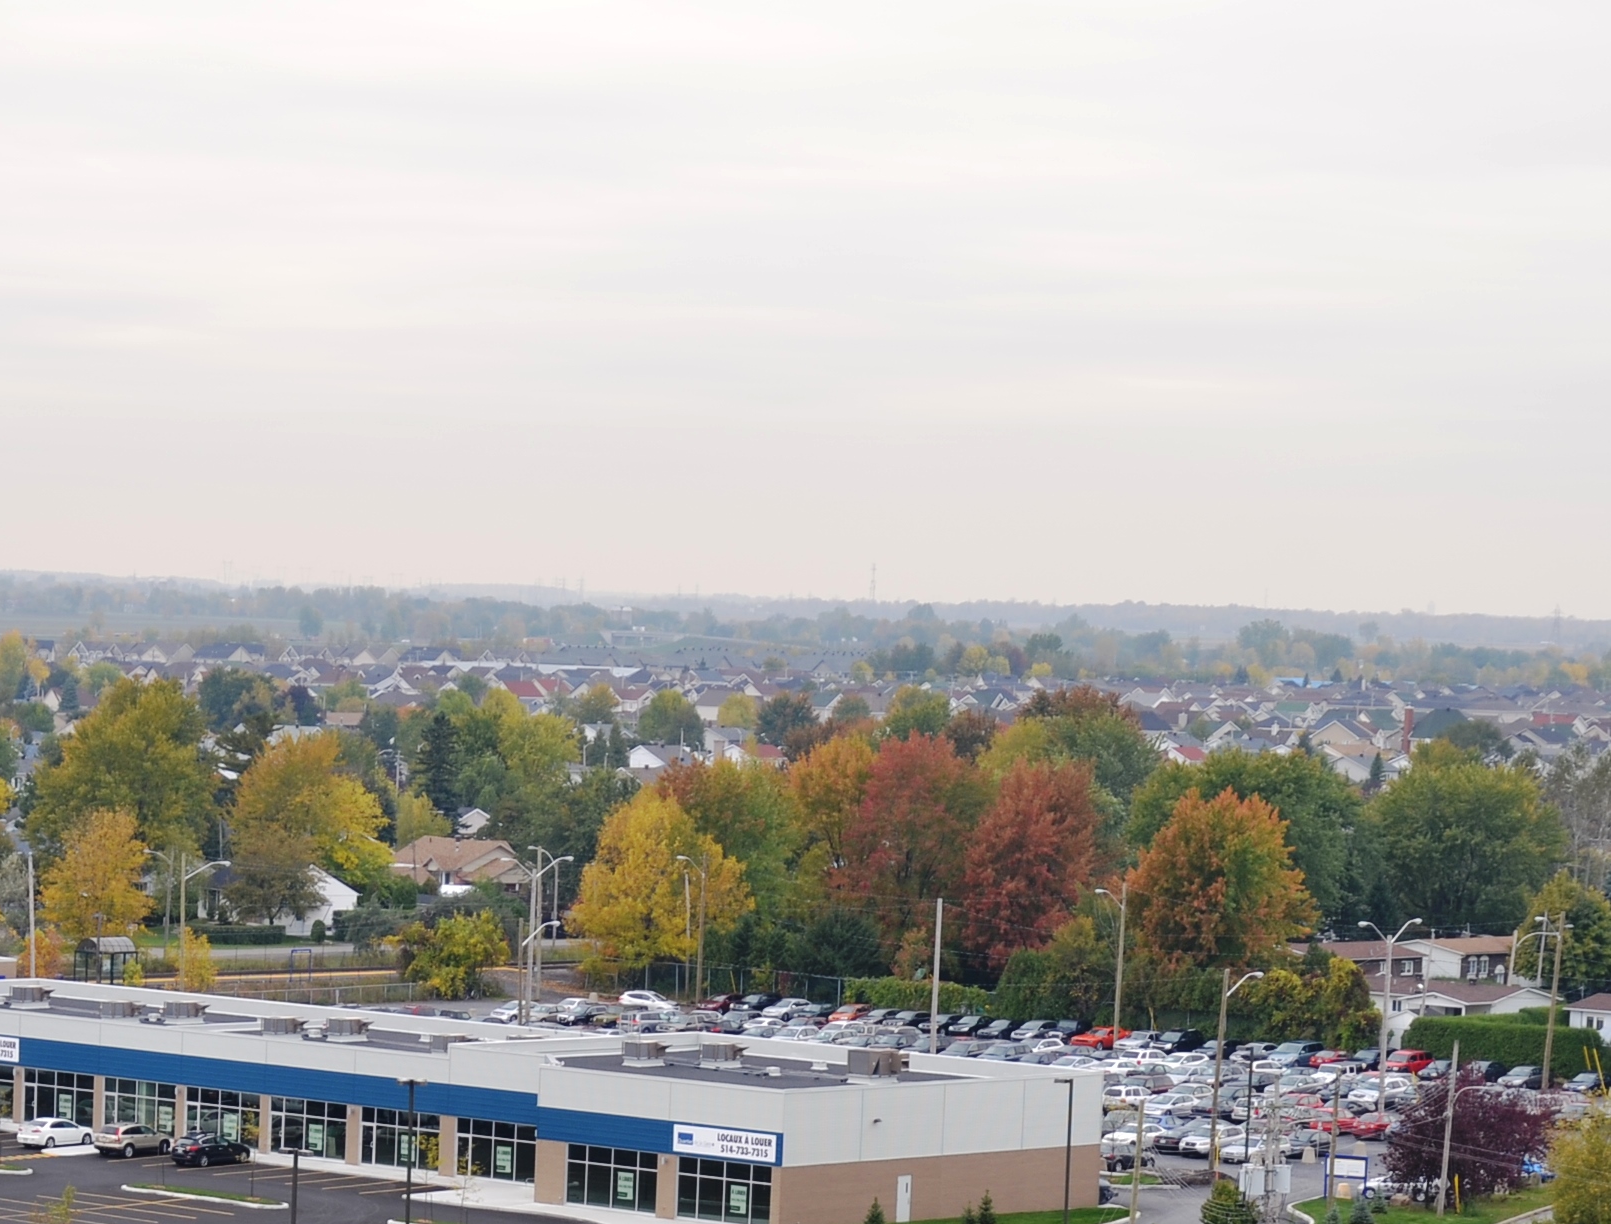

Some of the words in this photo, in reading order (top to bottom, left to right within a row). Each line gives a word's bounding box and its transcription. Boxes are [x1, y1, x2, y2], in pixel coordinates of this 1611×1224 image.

[0, 1040, 17, 1049] LOUER
[717, 1133, 743, 1144] LOCAUX
[751, 1138, 773, 1147] LOUER
[720, 1144, 769, 1158] 514-733-7315
